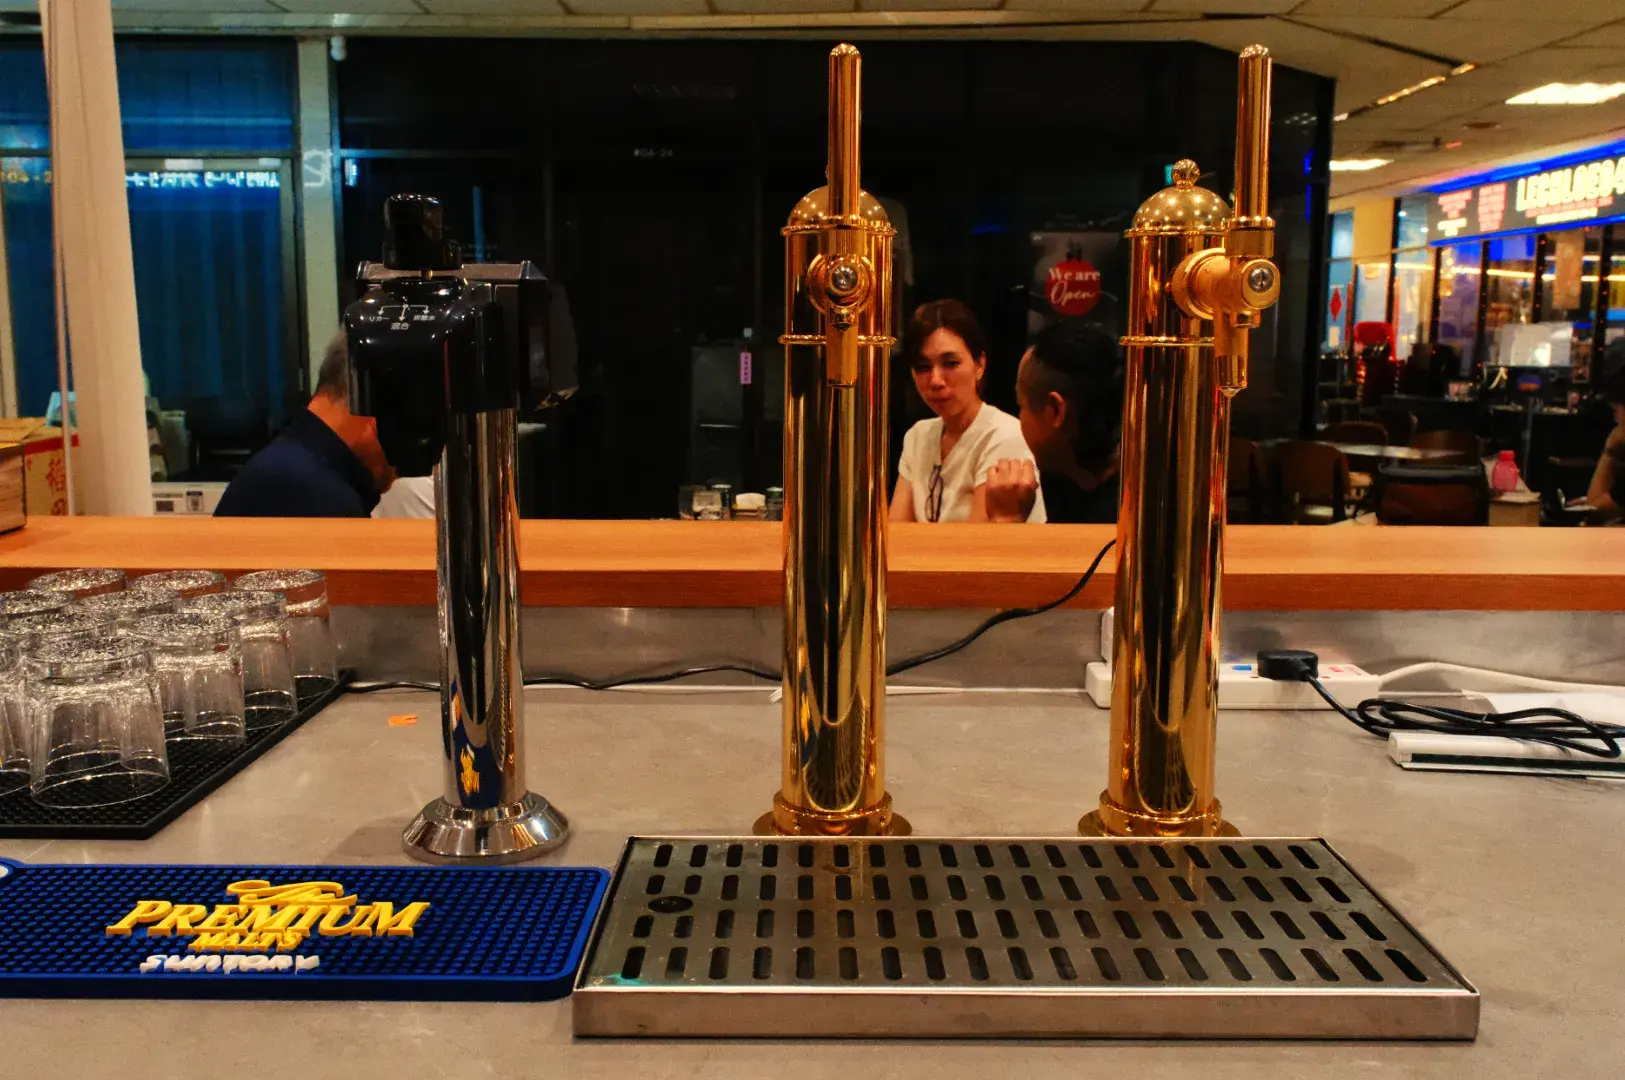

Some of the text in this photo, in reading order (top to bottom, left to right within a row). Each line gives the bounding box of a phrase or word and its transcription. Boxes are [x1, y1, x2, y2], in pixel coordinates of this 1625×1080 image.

[1049, 267, 1100, 281] We are
[1050, 280, 1096, 306] Open
[390, 322, 410, 331] 混合
[106, 900, 431, 937] PREMIUM
[139, 955, 320, 975] SUNTORY
